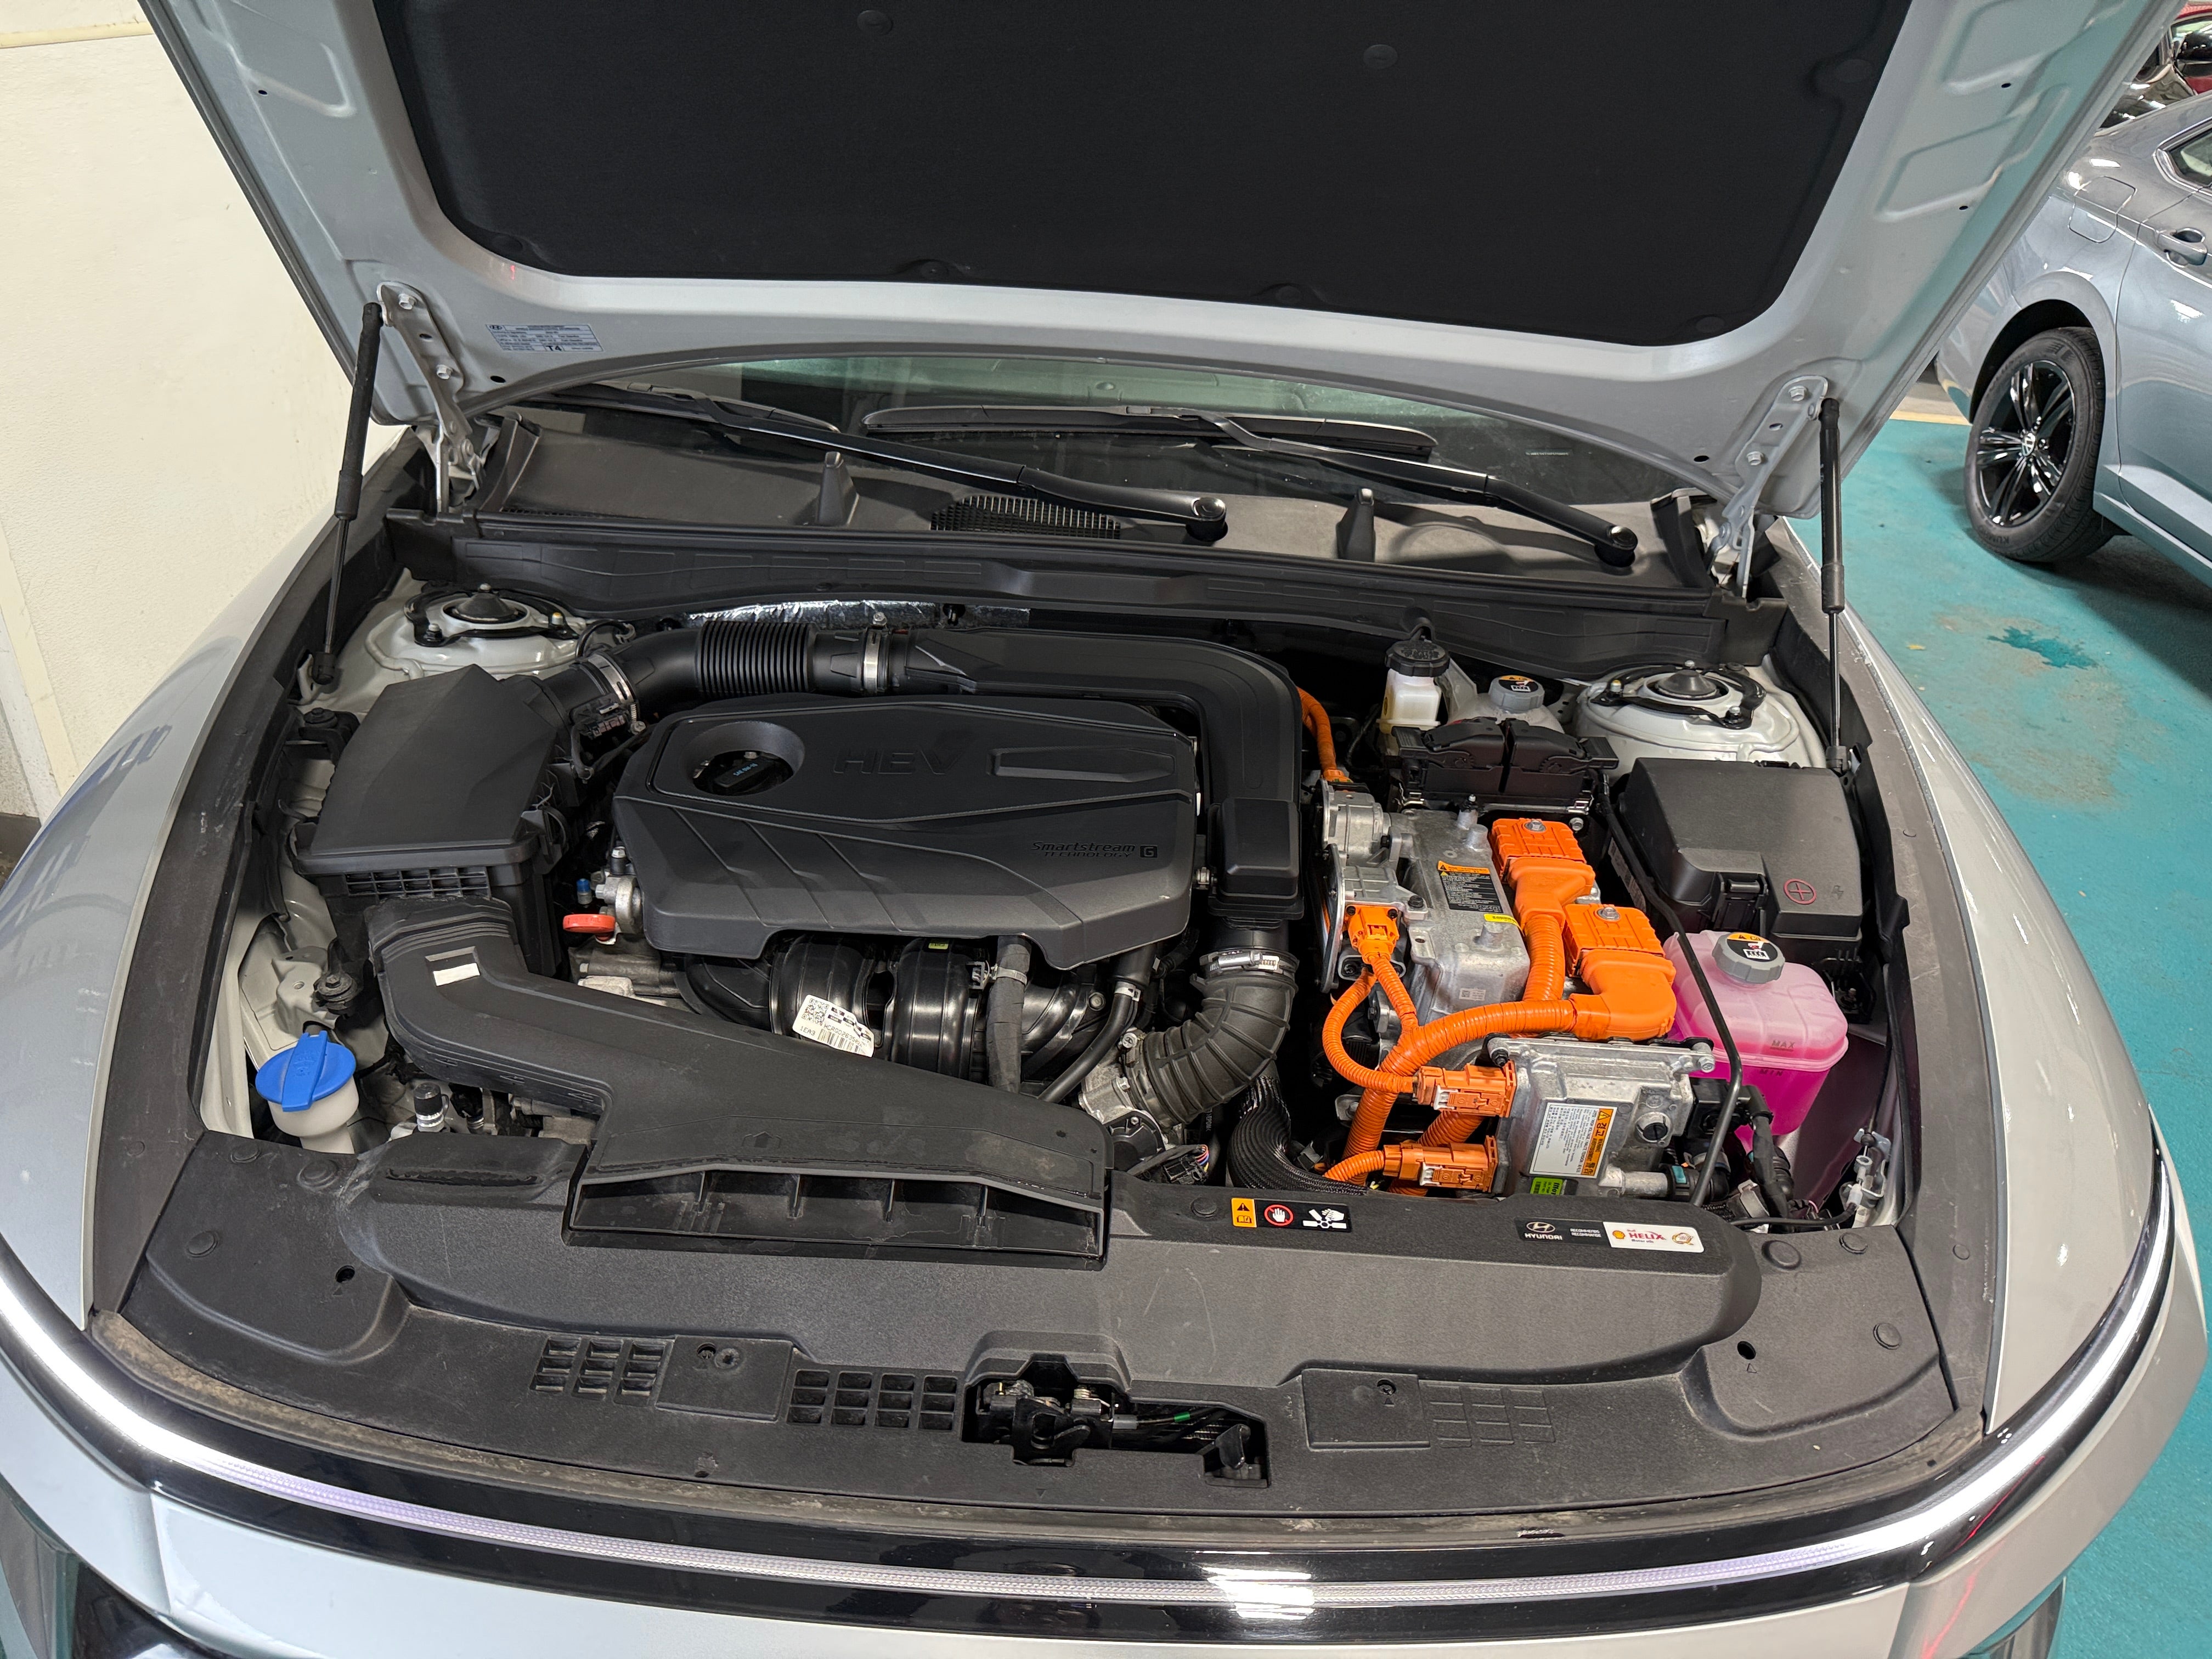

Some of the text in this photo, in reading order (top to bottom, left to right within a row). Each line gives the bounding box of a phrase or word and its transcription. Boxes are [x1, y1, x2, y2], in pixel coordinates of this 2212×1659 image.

[833, 747, 966, 775] HEV
[1032, 841, 1137, 852] Smartstream
[799, 1025, 816, 1036] 1EA3
[1772, 1040, 1795, 1048] MAX
[1759, 1068, 1783, 1076] MIN
[1595, 1122, 1607, 1137] 경고
[1525, 1232, 1563, 1240] HYUNDAI
[1628, 1232, 1666, 1240] HELIX
